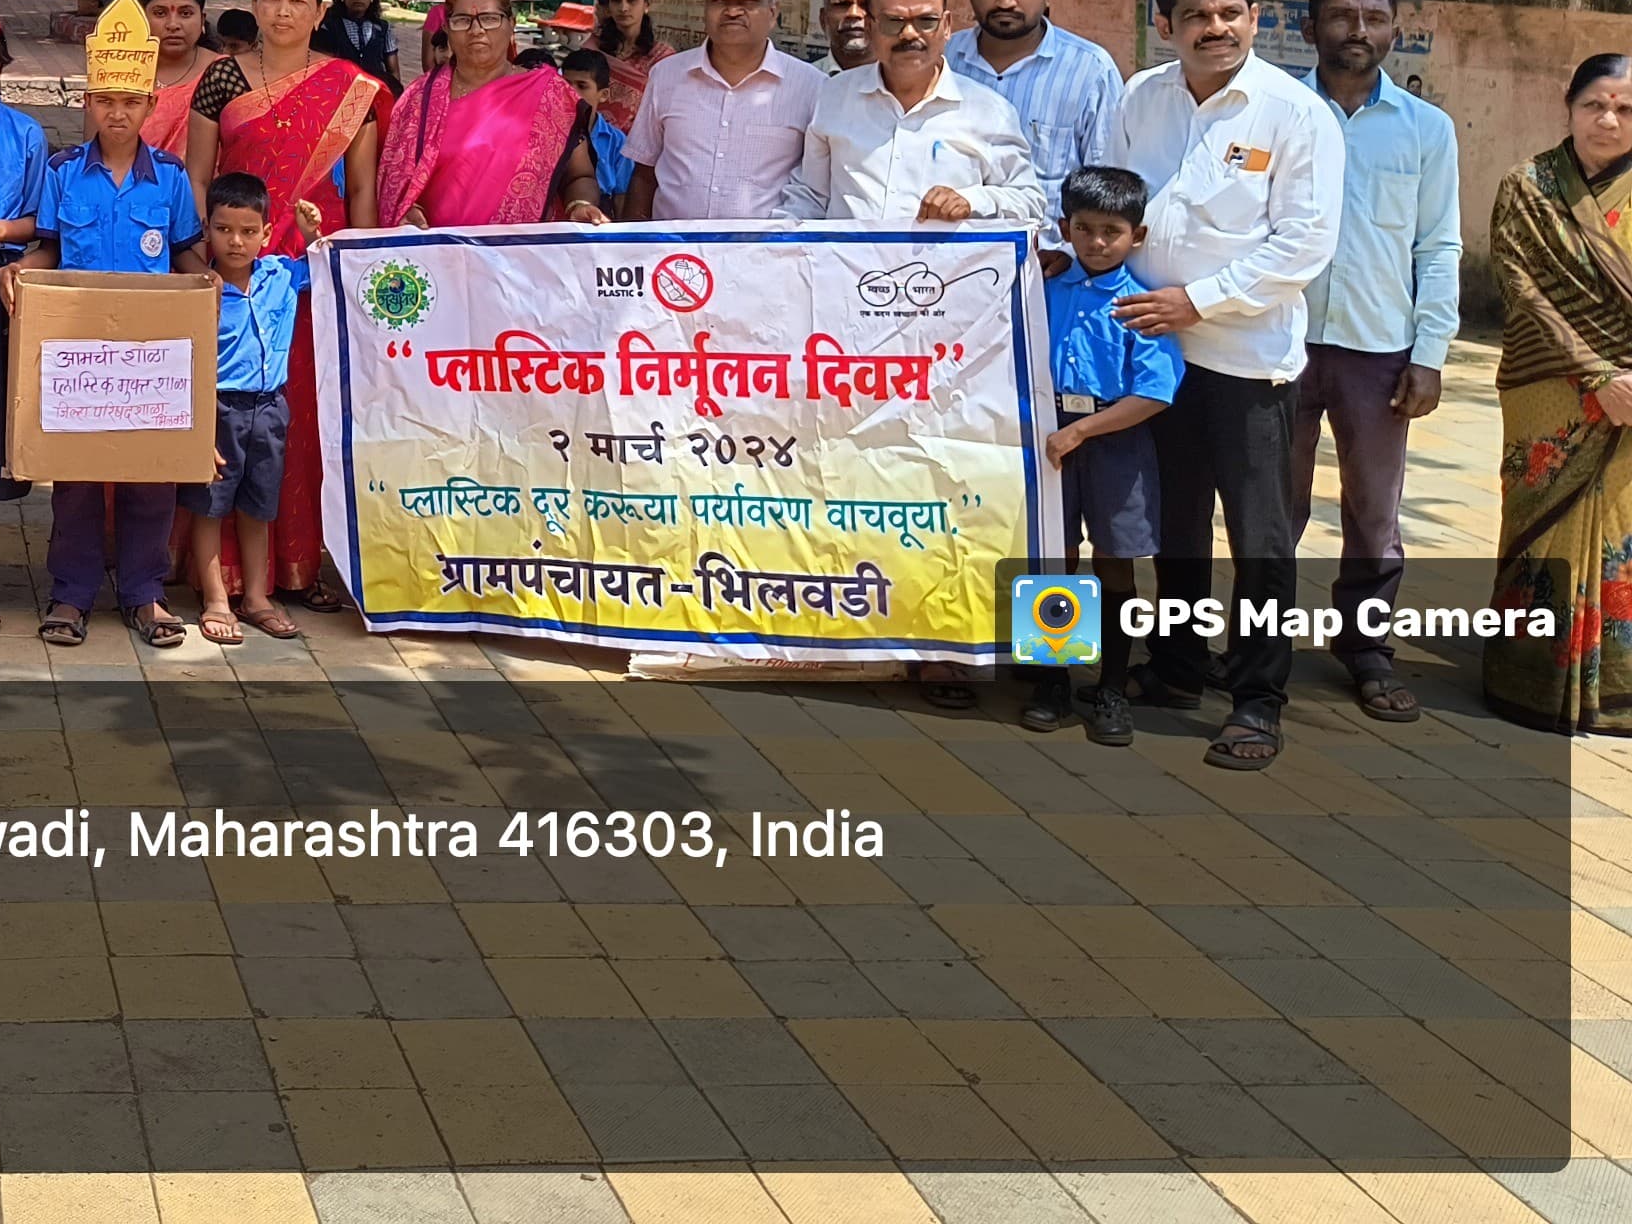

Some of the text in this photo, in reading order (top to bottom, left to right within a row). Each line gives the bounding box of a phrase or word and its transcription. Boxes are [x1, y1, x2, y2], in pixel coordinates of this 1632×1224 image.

[103, 21, 133, 43] मी
[596, 266, 644, 297] NO!
[598, 289, 635, 297] PLASTIC
[56, 345, 170, 367] आमची शाळा
[618, 331, 791, 418] निर्मूलन
[117, 378, 152, 404] मुक्त
[549, 421, 798, 469] २ मार्च २०२४
[533, 488, 571, 537] दूर
[690, 483, 814, 531] पर्यावरण
